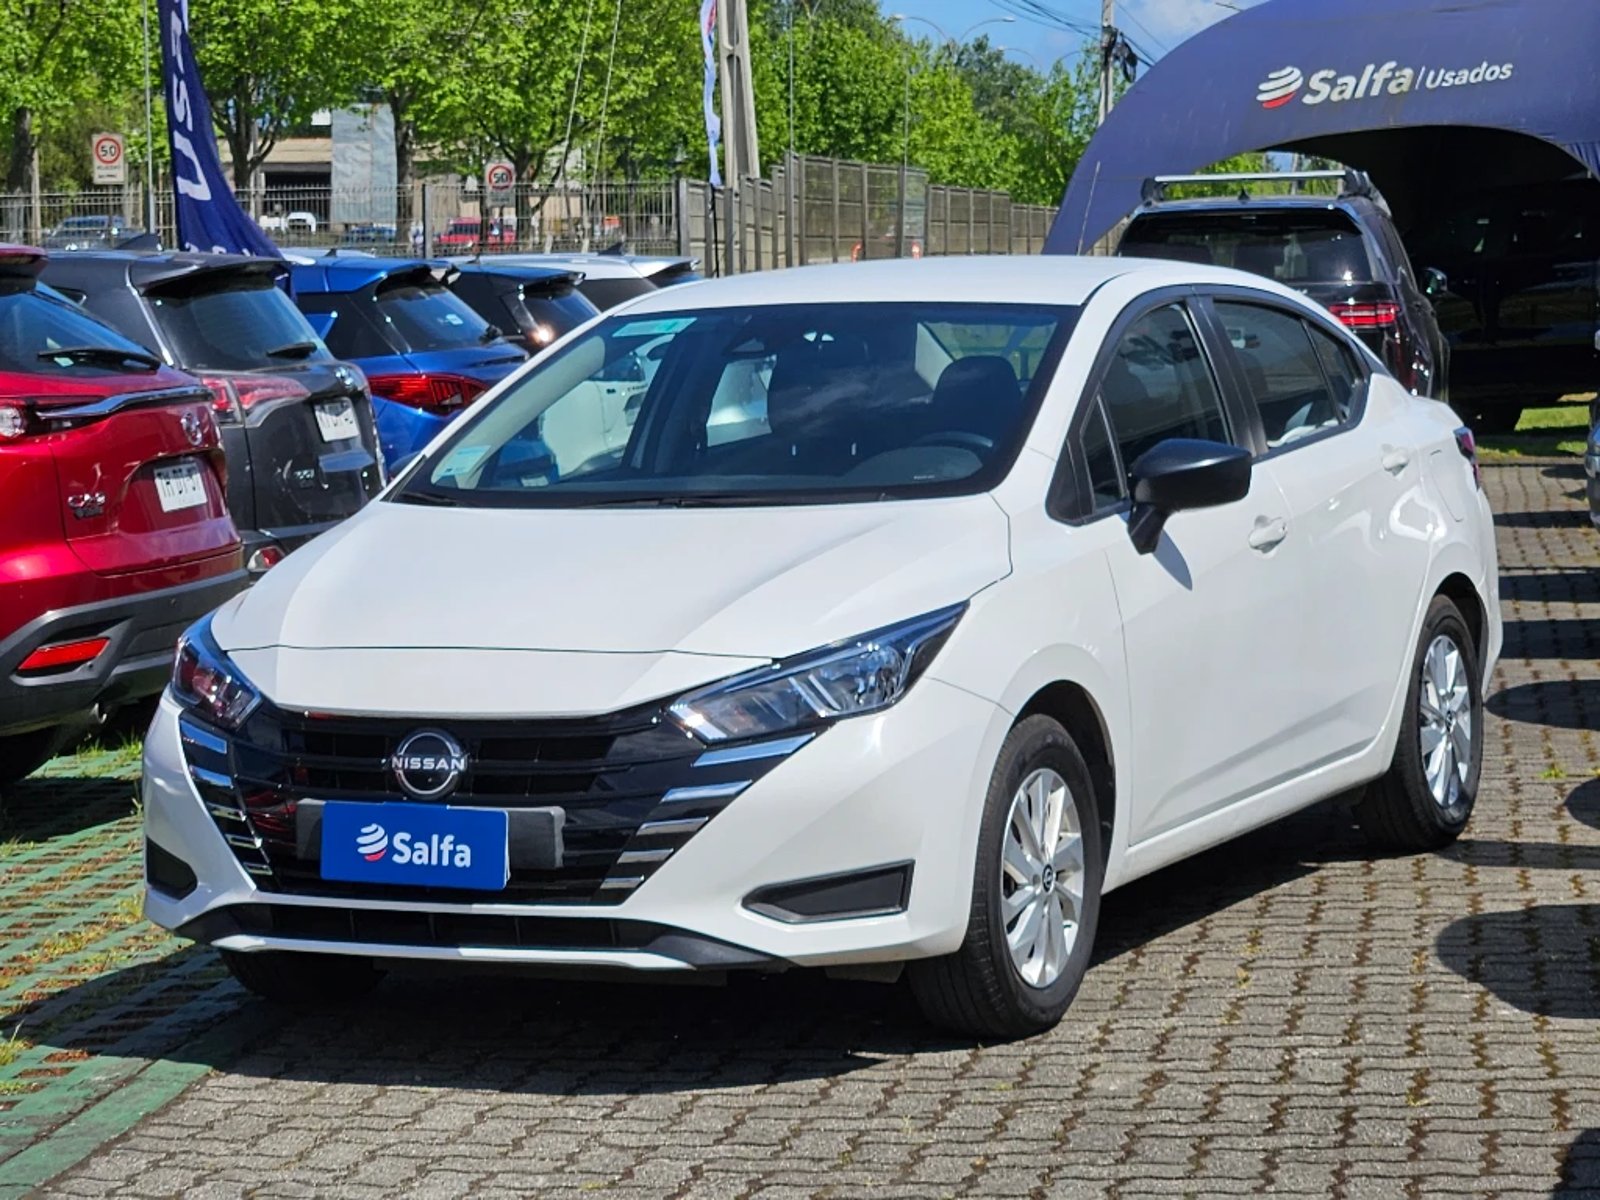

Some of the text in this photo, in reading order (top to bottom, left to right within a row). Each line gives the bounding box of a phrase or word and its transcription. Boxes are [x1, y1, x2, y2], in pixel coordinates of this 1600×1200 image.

[1301, 61, 1514, 104] Salfa Usados
[101, 145, 116, 157] 50
[493, 172, 508, 184] 50
[391, 757, 465, 771] NISSAN
[392, 832, 471, 868] Salfa
